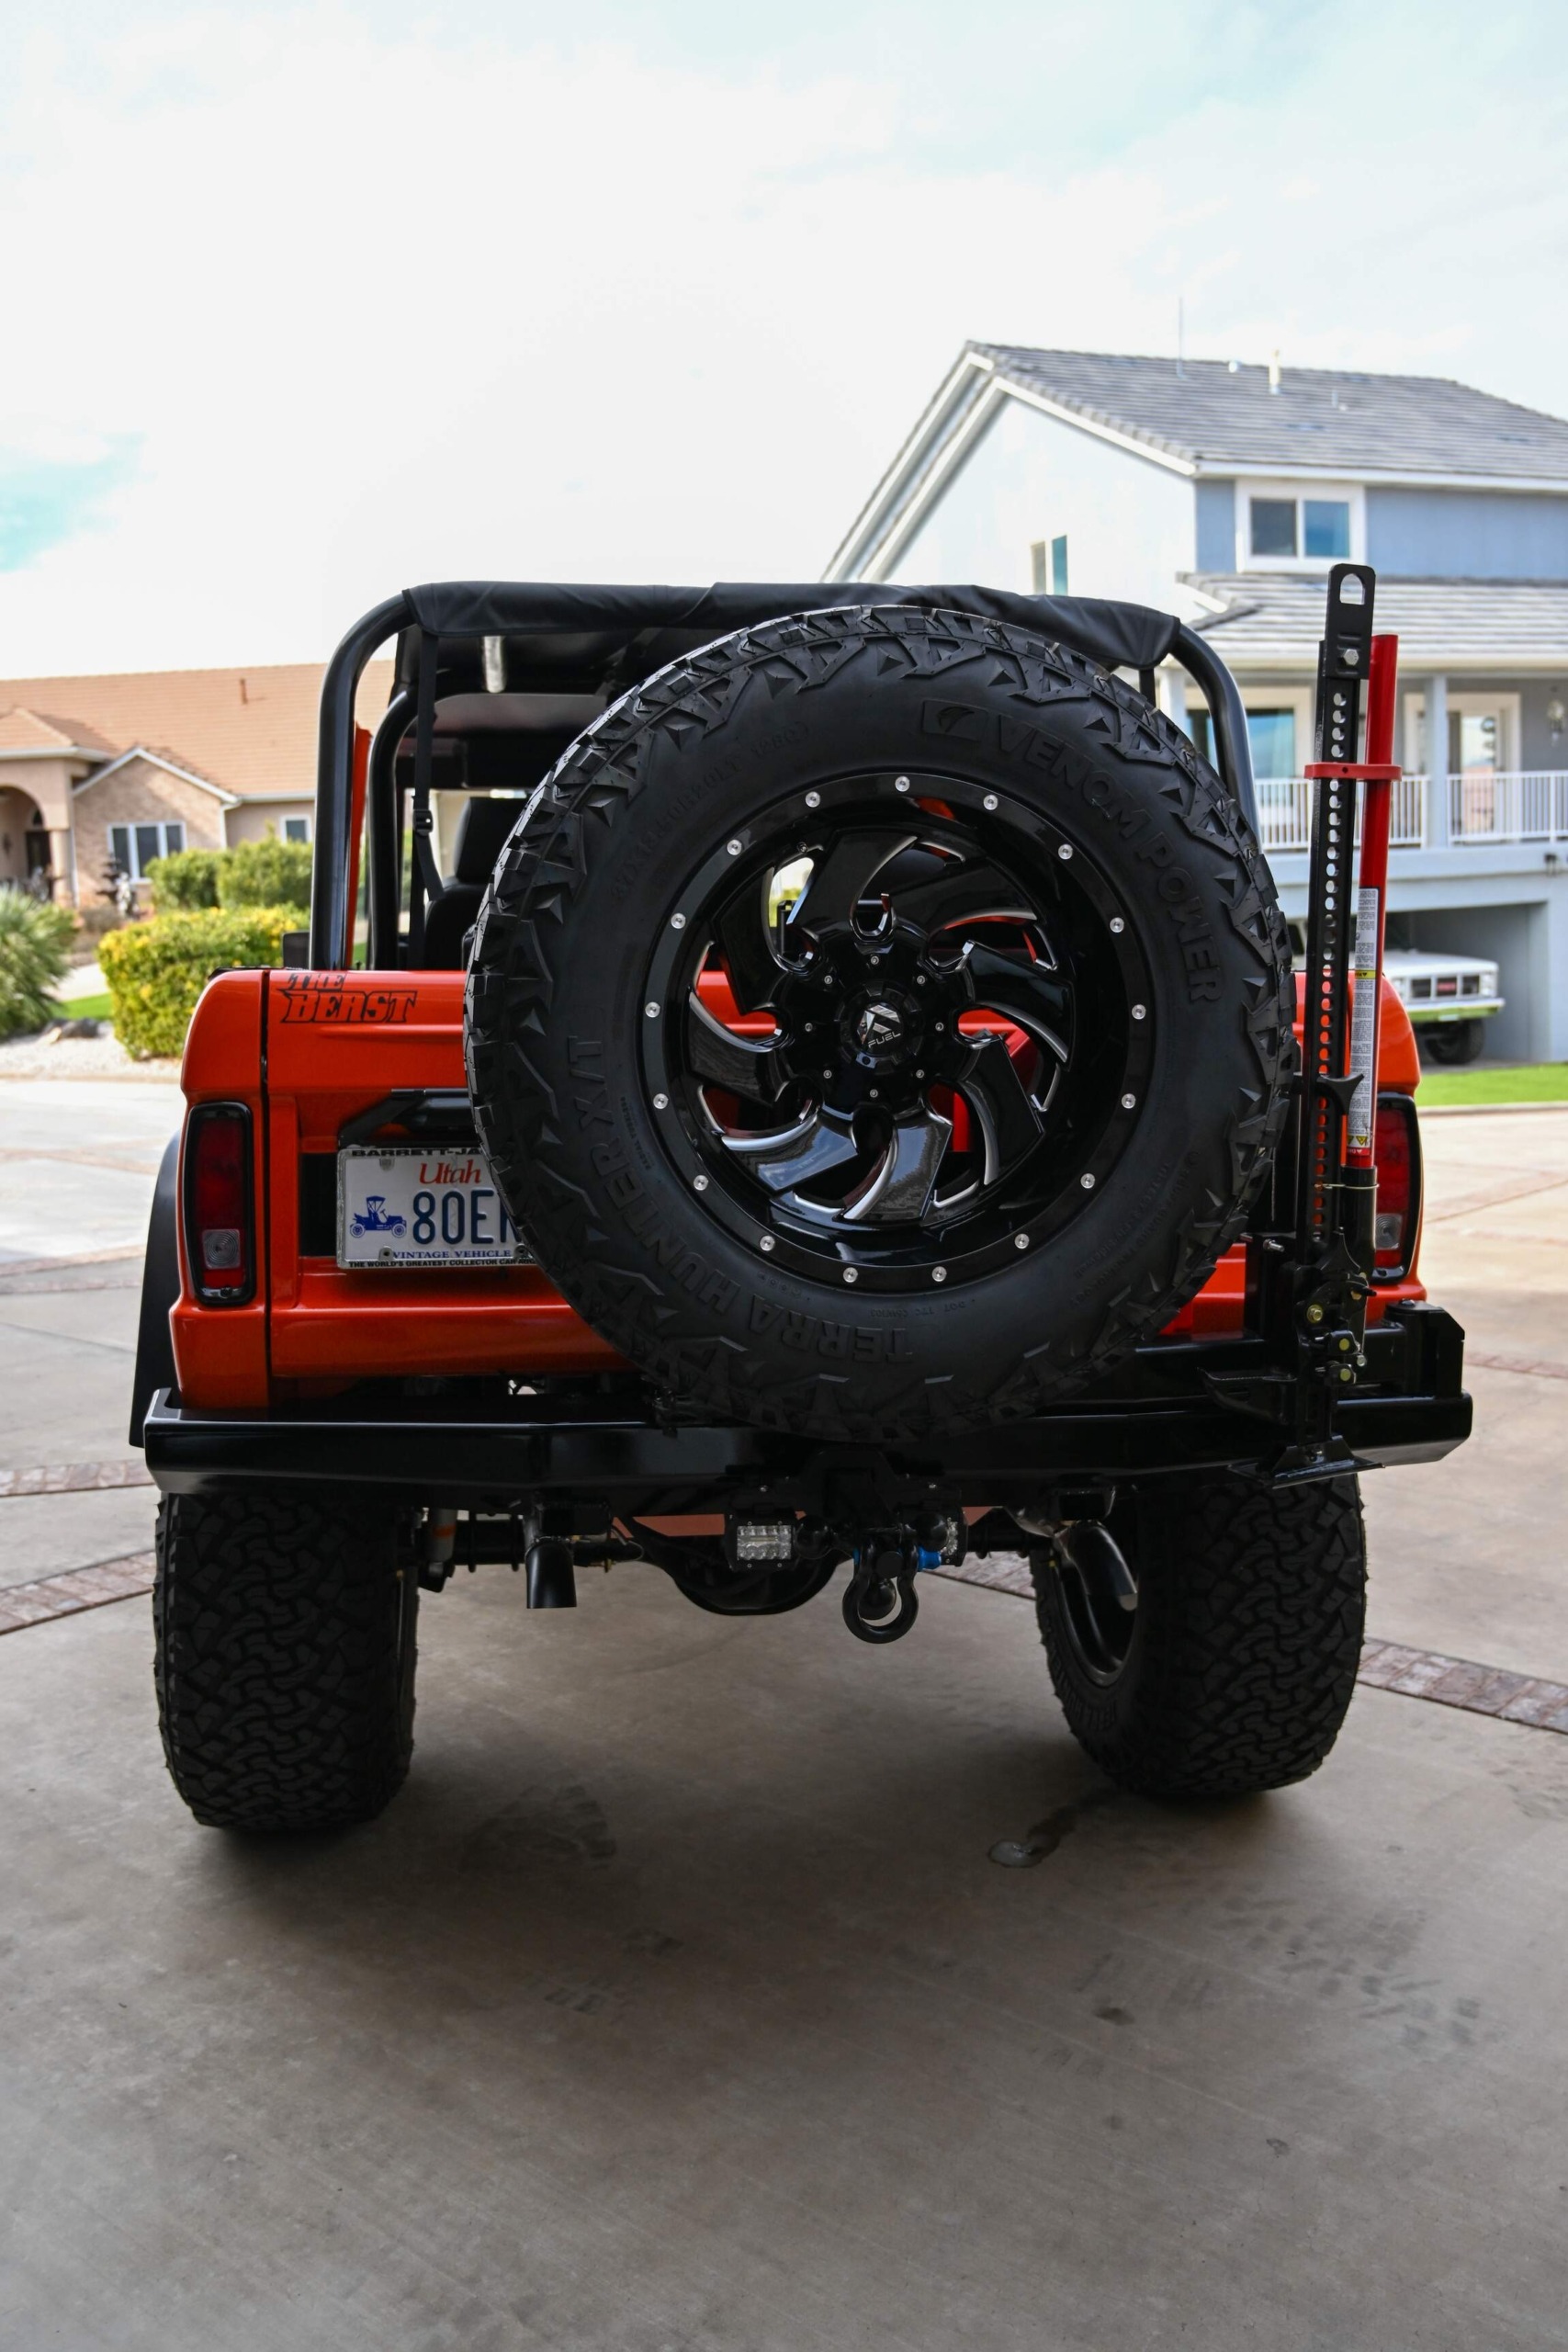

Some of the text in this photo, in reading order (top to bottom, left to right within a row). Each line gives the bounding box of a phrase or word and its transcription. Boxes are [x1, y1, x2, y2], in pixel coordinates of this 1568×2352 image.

[996, 712, 1226, 1002] VENOM POWER
[288, 972, 347, 991] THE
[277, 989, 418, 1023] BEAST
[868, 1031, 901, 1048] FUEL
[420, 1159, 482, 1184] Utah
[591, 1136, 741, 1315] HUNTER
[393, 1250, 512, 1259] VINTAGE VEHICLE
[406, 1259, 448, 1267] GREATEST
[450, 1258, 498, 1266] COLLECTOR
[747, 1294, 914, 1363] TERRA
